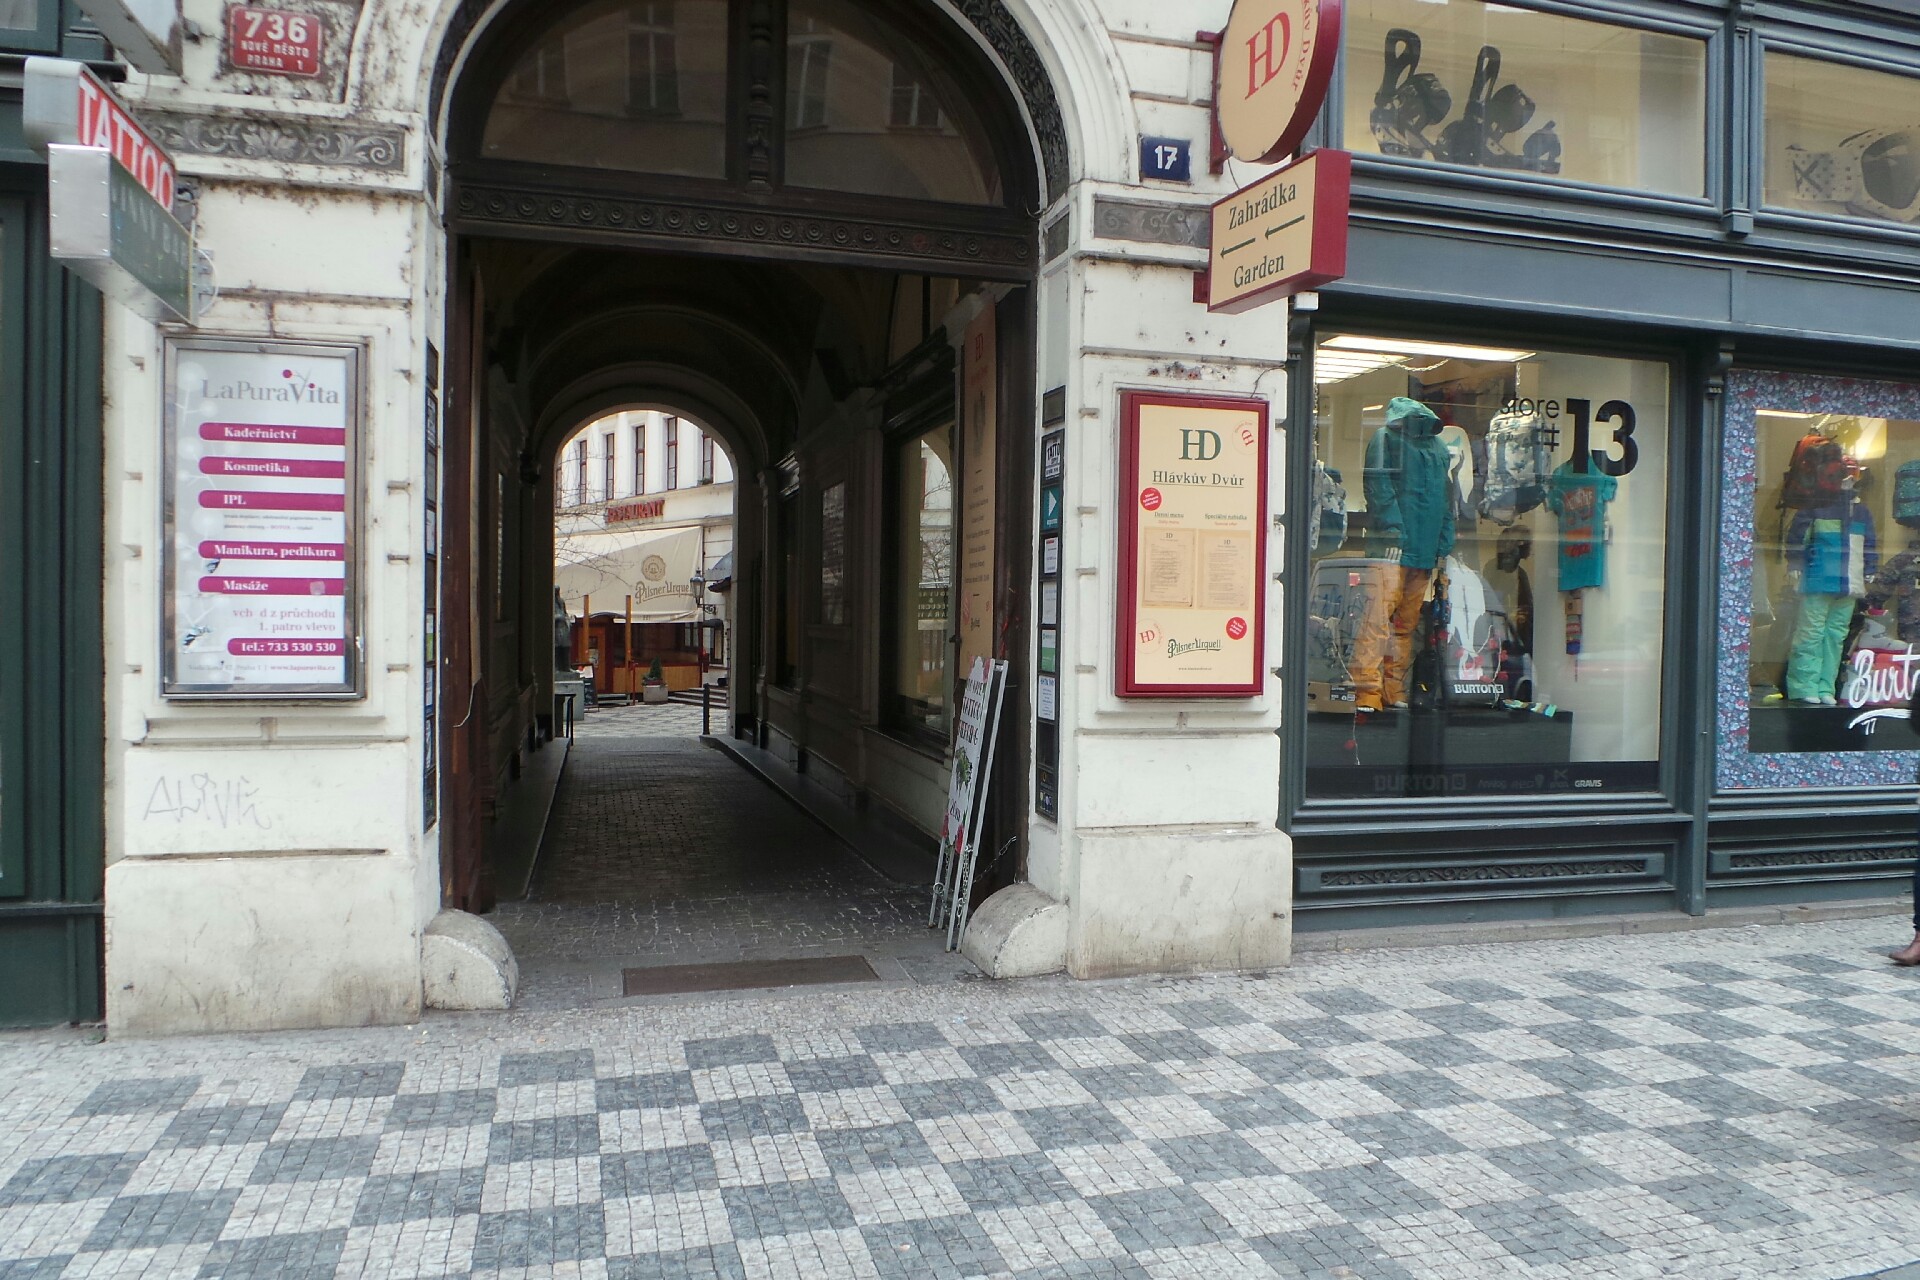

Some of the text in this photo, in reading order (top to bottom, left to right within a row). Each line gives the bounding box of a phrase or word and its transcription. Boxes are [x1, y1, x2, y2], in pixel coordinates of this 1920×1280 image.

[244, 11, 307, 43] 736
[241, 40, 309, 58] NOVÉ MĚSTO
[1245, 11, 1290, 100] HD
[247, 54, 303, 70] PRAHA 1
[79, 74, 174, 213] TATTOO
[1154, 145, 1177, 170] 17
[1229, 182, 1297, 230] Zahrádka
[1233, 254, 1285, 289] Garden
[224, 427, 297, 440] Kadeřnictví
[1566, 398, 1639, 477] 13
[1178, 428, 1222, 461] HD
[224, 461, 290, 473] Kosmetika
[223, 494, 247, 505] IPL
[214, 544, 336, 558] Manikura, pedikura
[223, 579, 269, 591] Masáže
[635, 581, 666, 605] Pilsner
[279, 608, 336, 620] průchodu
[259, 622, 336, 633] 1. patro vlevo
[242, 643, 336, 652] tel.: 733 530 530
[1167, 638, 1221, 659] Pilsner Urquell
[1453, 684, 1495, 693] BURTON
[1574, 779, 1603, 788] GRAVIS
